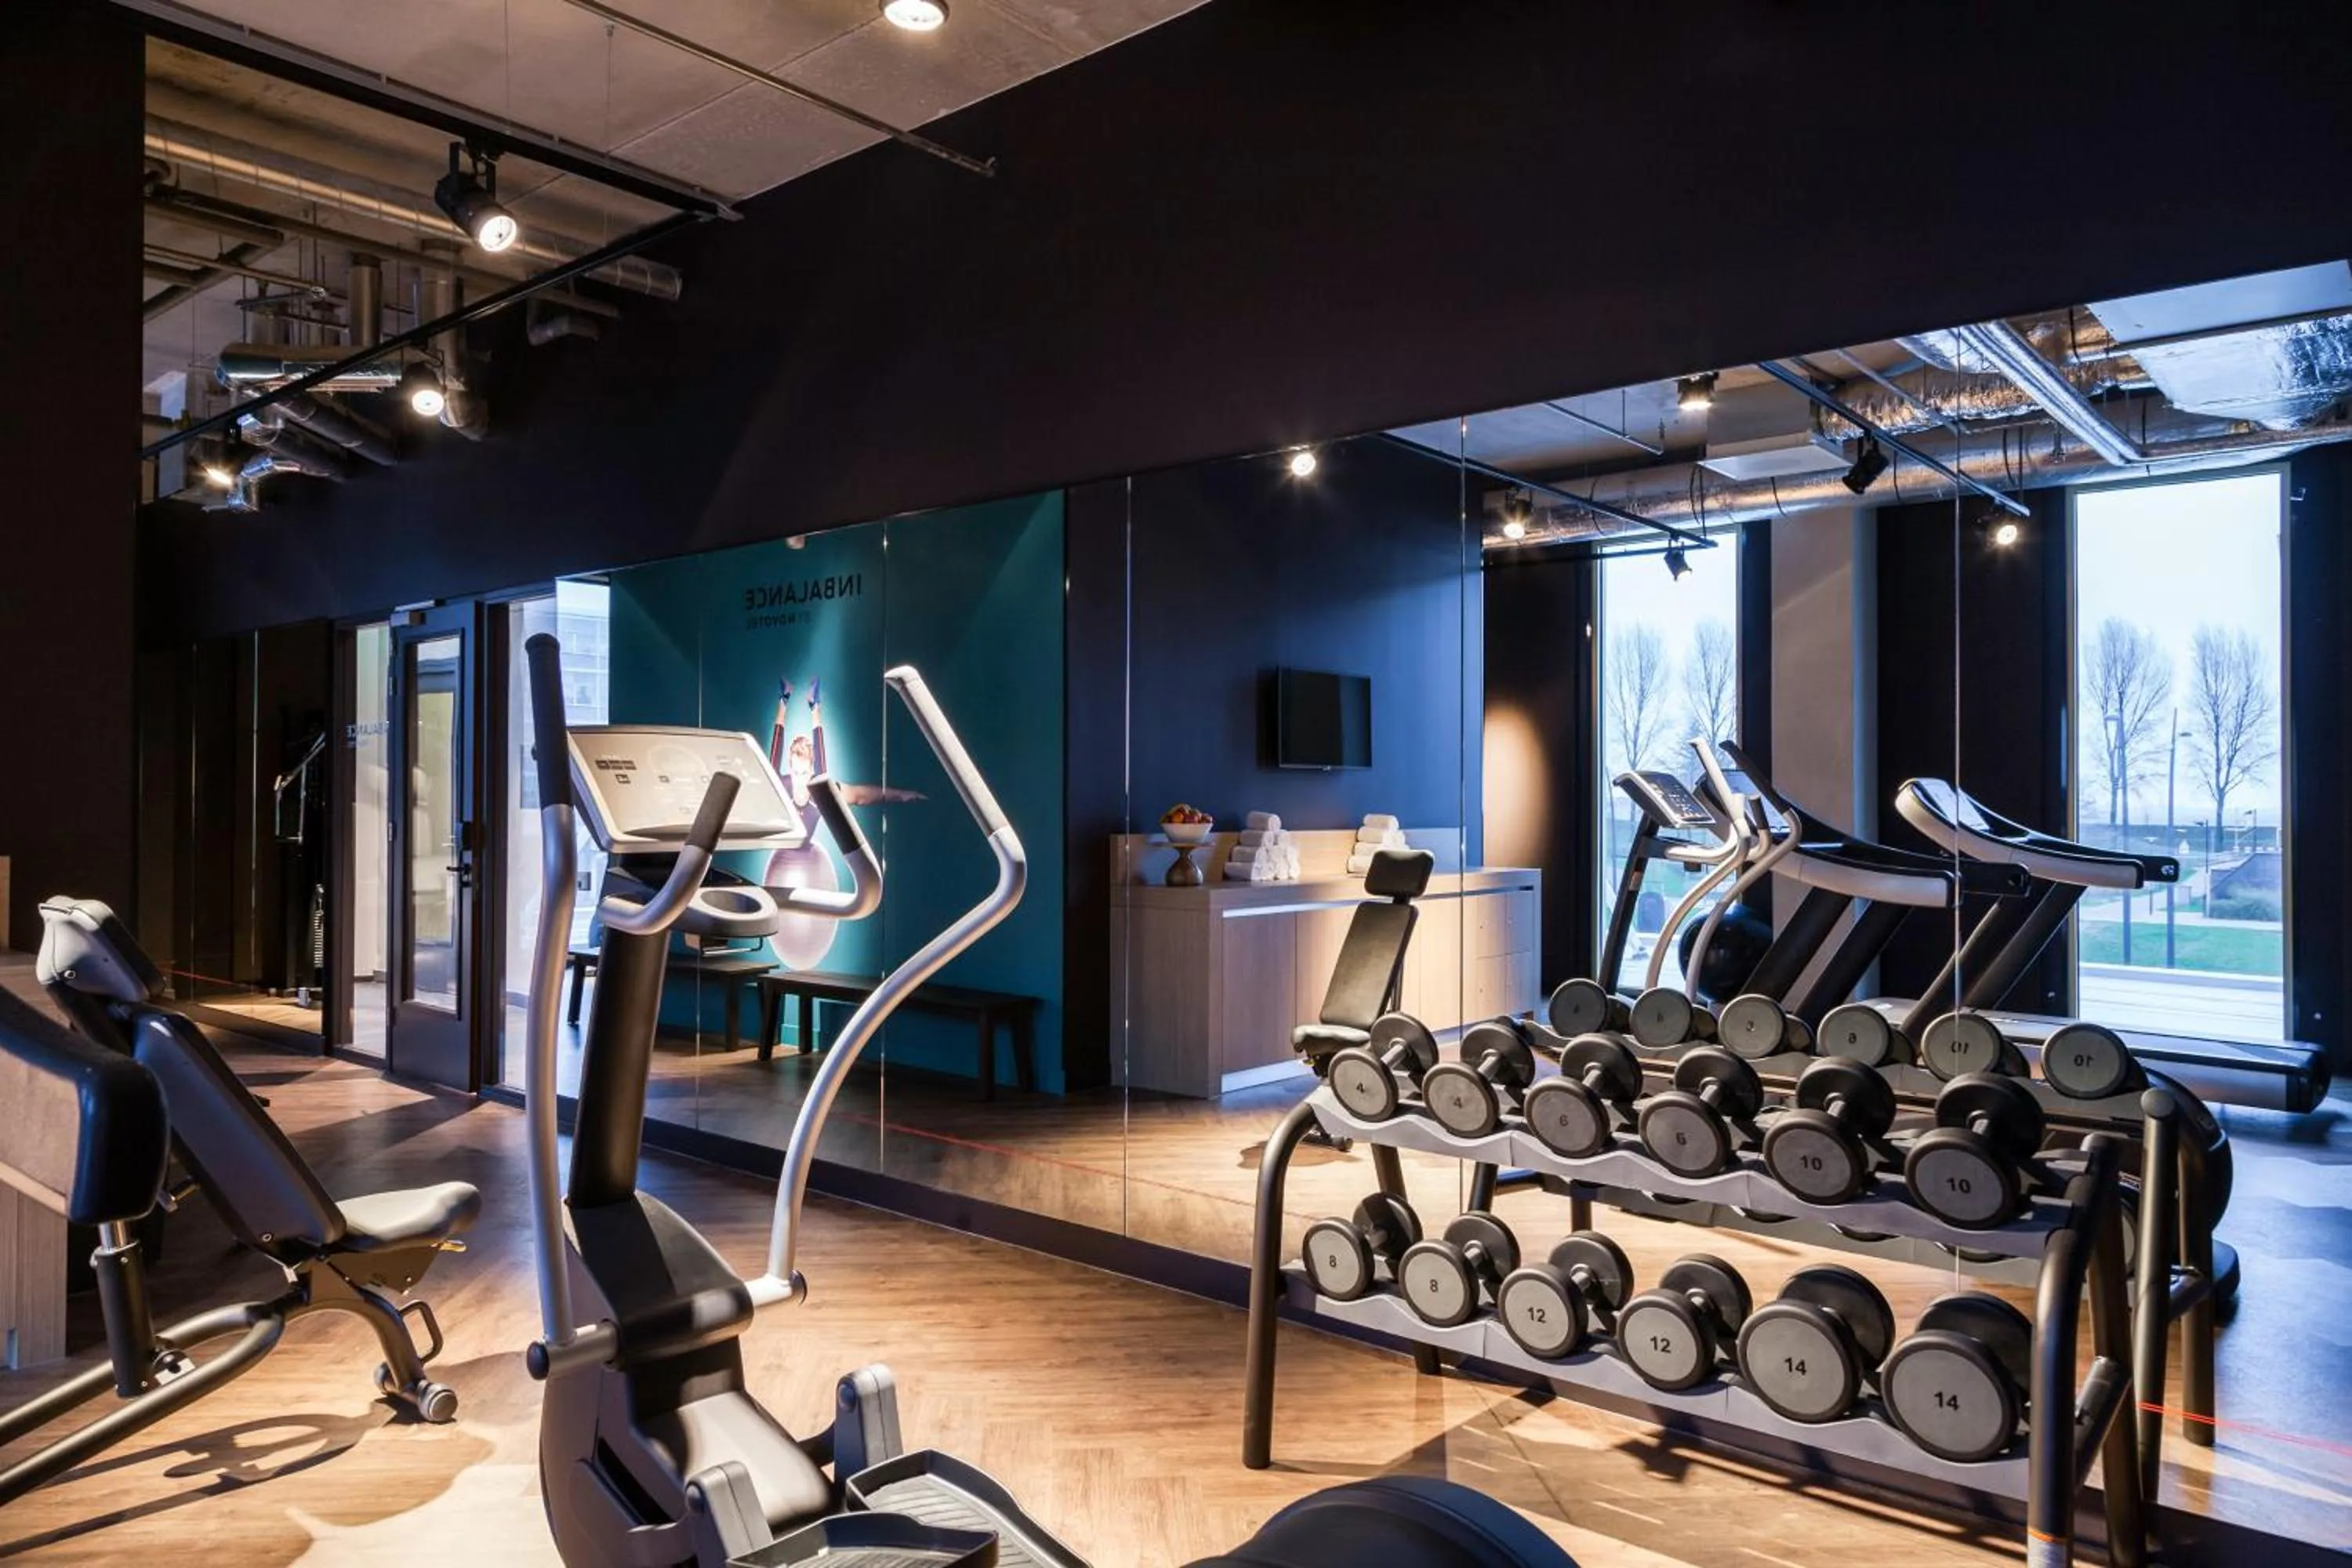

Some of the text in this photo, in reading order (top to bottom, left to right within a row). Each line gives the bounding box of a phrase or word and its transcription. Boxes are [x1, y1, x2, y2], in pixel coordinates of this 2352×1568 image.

[1356, 1083, 1366, 1094] 4
[1453, 1097, 1463, 1109] 4
[1559, 1114, 1569, 1128] 6
[1675, 1132, 1687, 1146] 6
[1800, 1155, 1823, 1171] 10
[1947, 1178, 1971, 1195] 10
[1328, 1254, 1338, 1269] 8
[1429, 1279, 1439, 1293] 8
[1527, 1307, 1546, 1323] 12
[1650, 1336, 1671, 1353] 12
[1784, 1357, 1807, 1376] 14
[1934, 1392, 1960, 1411] 14
